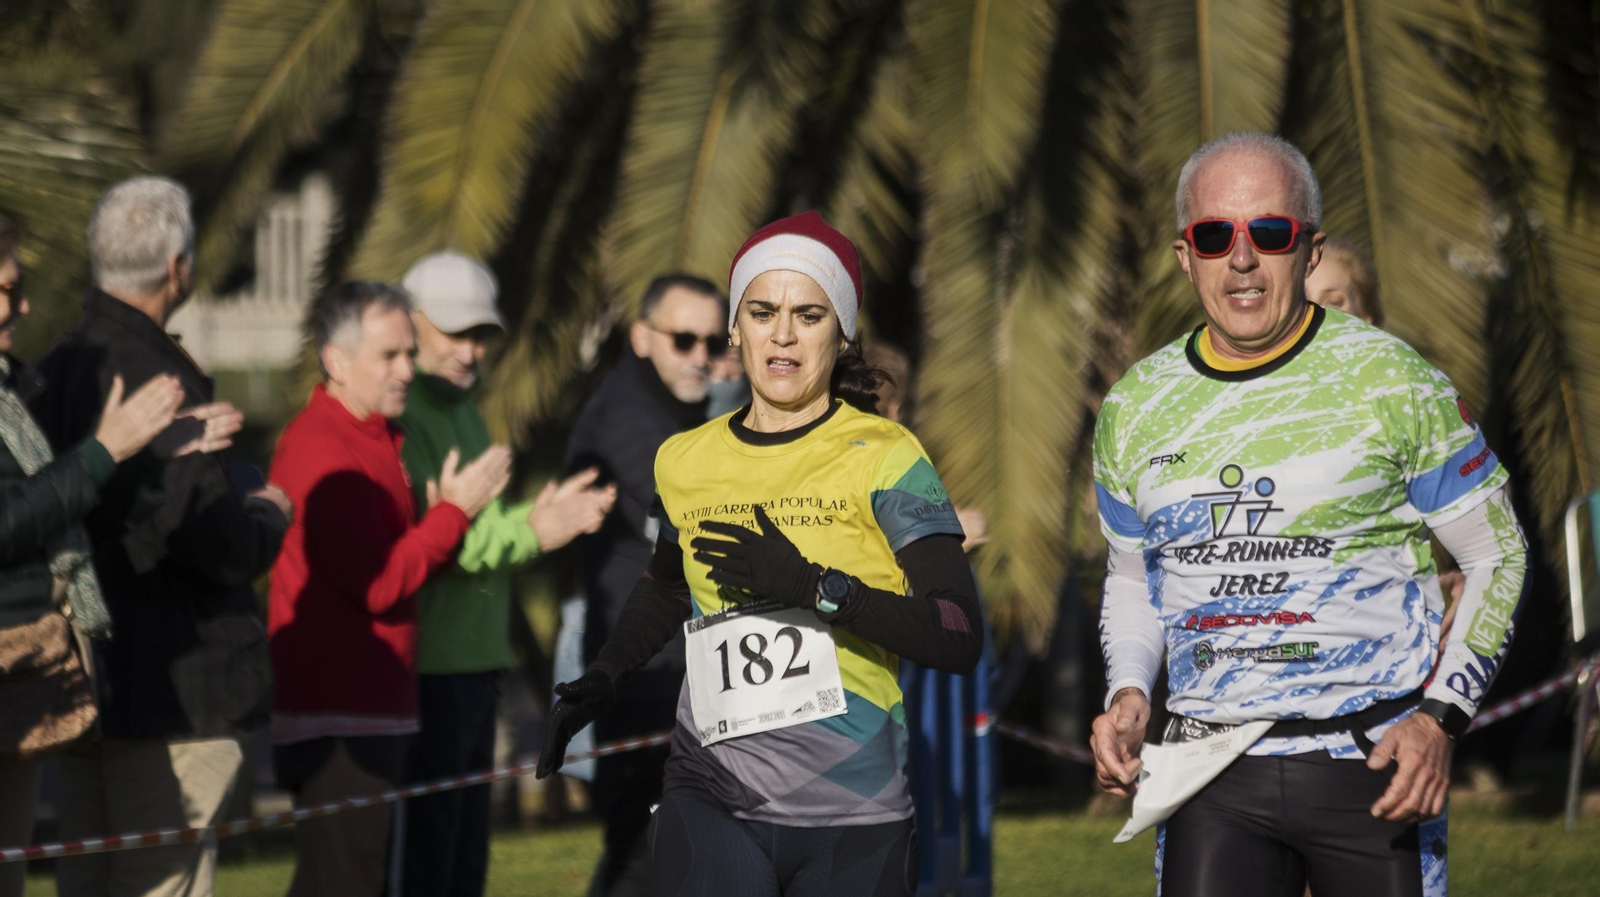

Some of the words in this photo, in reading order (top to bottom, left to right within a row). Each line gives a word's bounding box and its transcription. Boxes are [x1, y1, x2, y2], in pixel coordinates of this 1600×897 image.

[1149, 451, 1188, 469] FRX
[680, 506, 712, 522] XXVIII
[780, 496, 848, 511] POPULAR
[1174, 538, 1336, 565] VETE-RUNNERS
[1209, 571, 1290, 598] JEREZ
[1199, 611, 1317, 630] SECOVISA
[714, 626, 810, 694] 182
